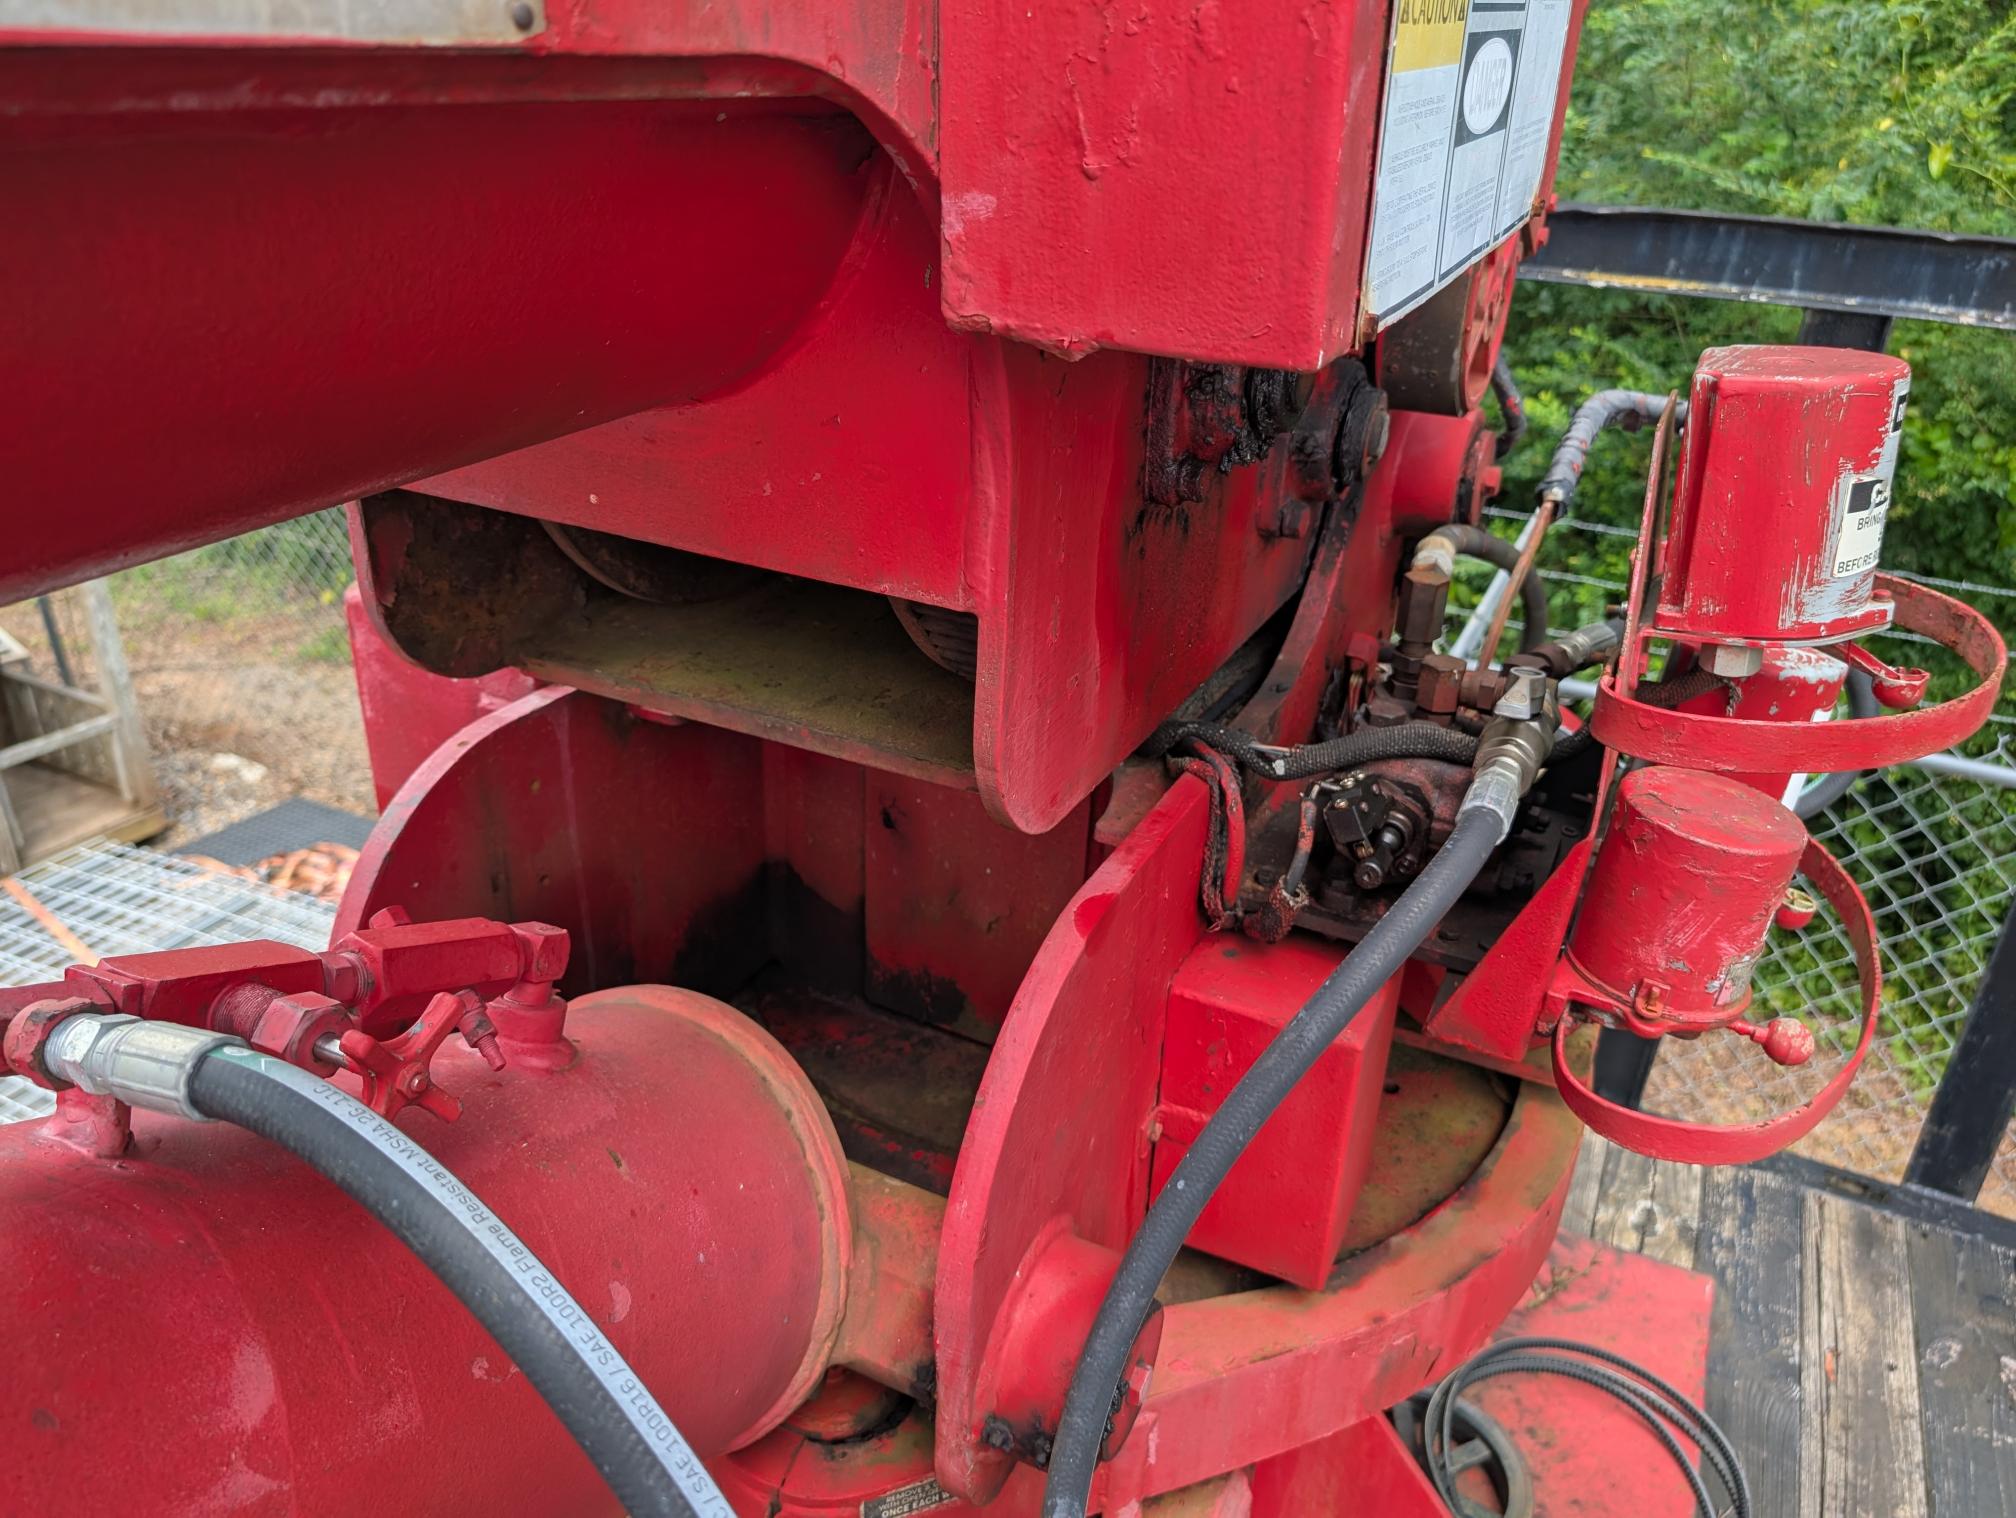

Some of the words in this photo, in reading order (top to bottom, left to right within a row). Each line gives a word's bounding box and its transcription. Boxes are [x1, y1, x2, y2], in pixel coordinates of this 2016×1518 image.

[1411, 0, 1459, 25] CAUTION
[1837, 552, 1874, 574] BEFORE
[372, 1119, 420, 1161] MSHA
[415, 1158, 491, 1225] Resistant
[487, 1223, 536, 1274] Flame
[531, 1272, 588, 1330] 100R2
[579, 1329, 615, 1367] SAE
[619, 1378, 681, 1452] 100R16
[674, 1453, 709, 1494] SAE
[881, 1503, 910, 1518] ONCE
[912, 1495, 939, 1509] EACH
[886, 1487, 922, 1502] REMOVE
[901, 1491, 927, 1505] OPEN
